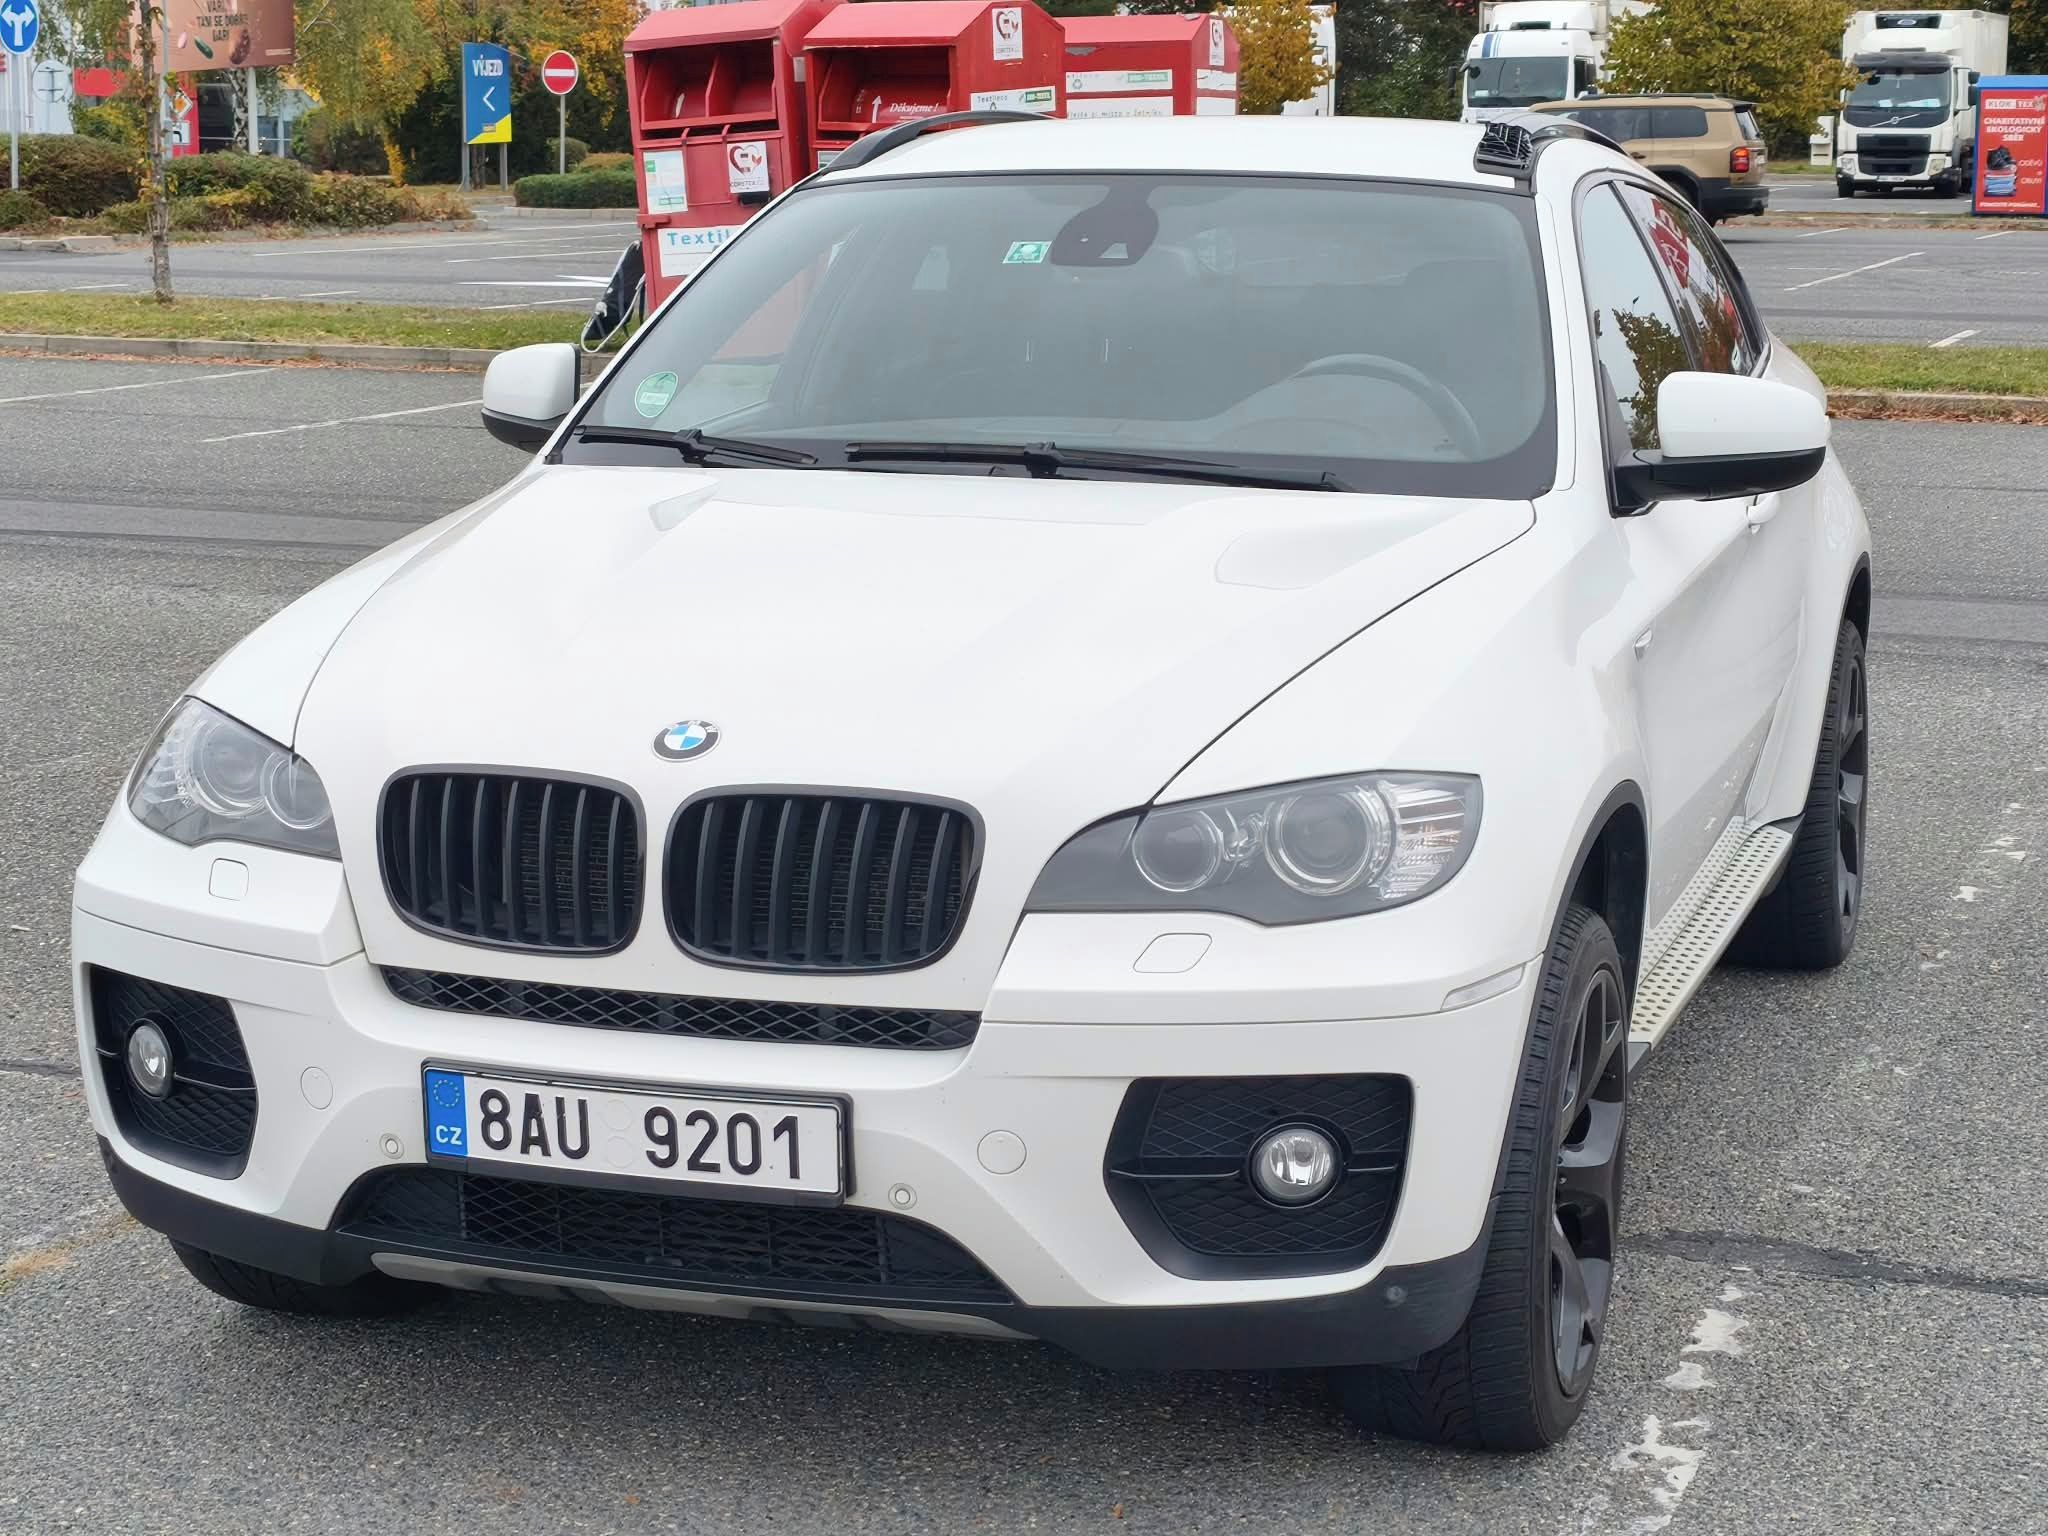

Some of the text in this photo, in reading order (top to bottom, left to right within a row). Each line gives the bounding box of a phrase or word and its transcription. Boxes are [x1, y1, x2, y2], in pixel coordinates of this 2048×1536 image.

[472, 54, 504, 77] VÝJEZD
[435, 1124, 463, 1146] CZ
[479, 1088, 801, 1181] 8AU 9201
